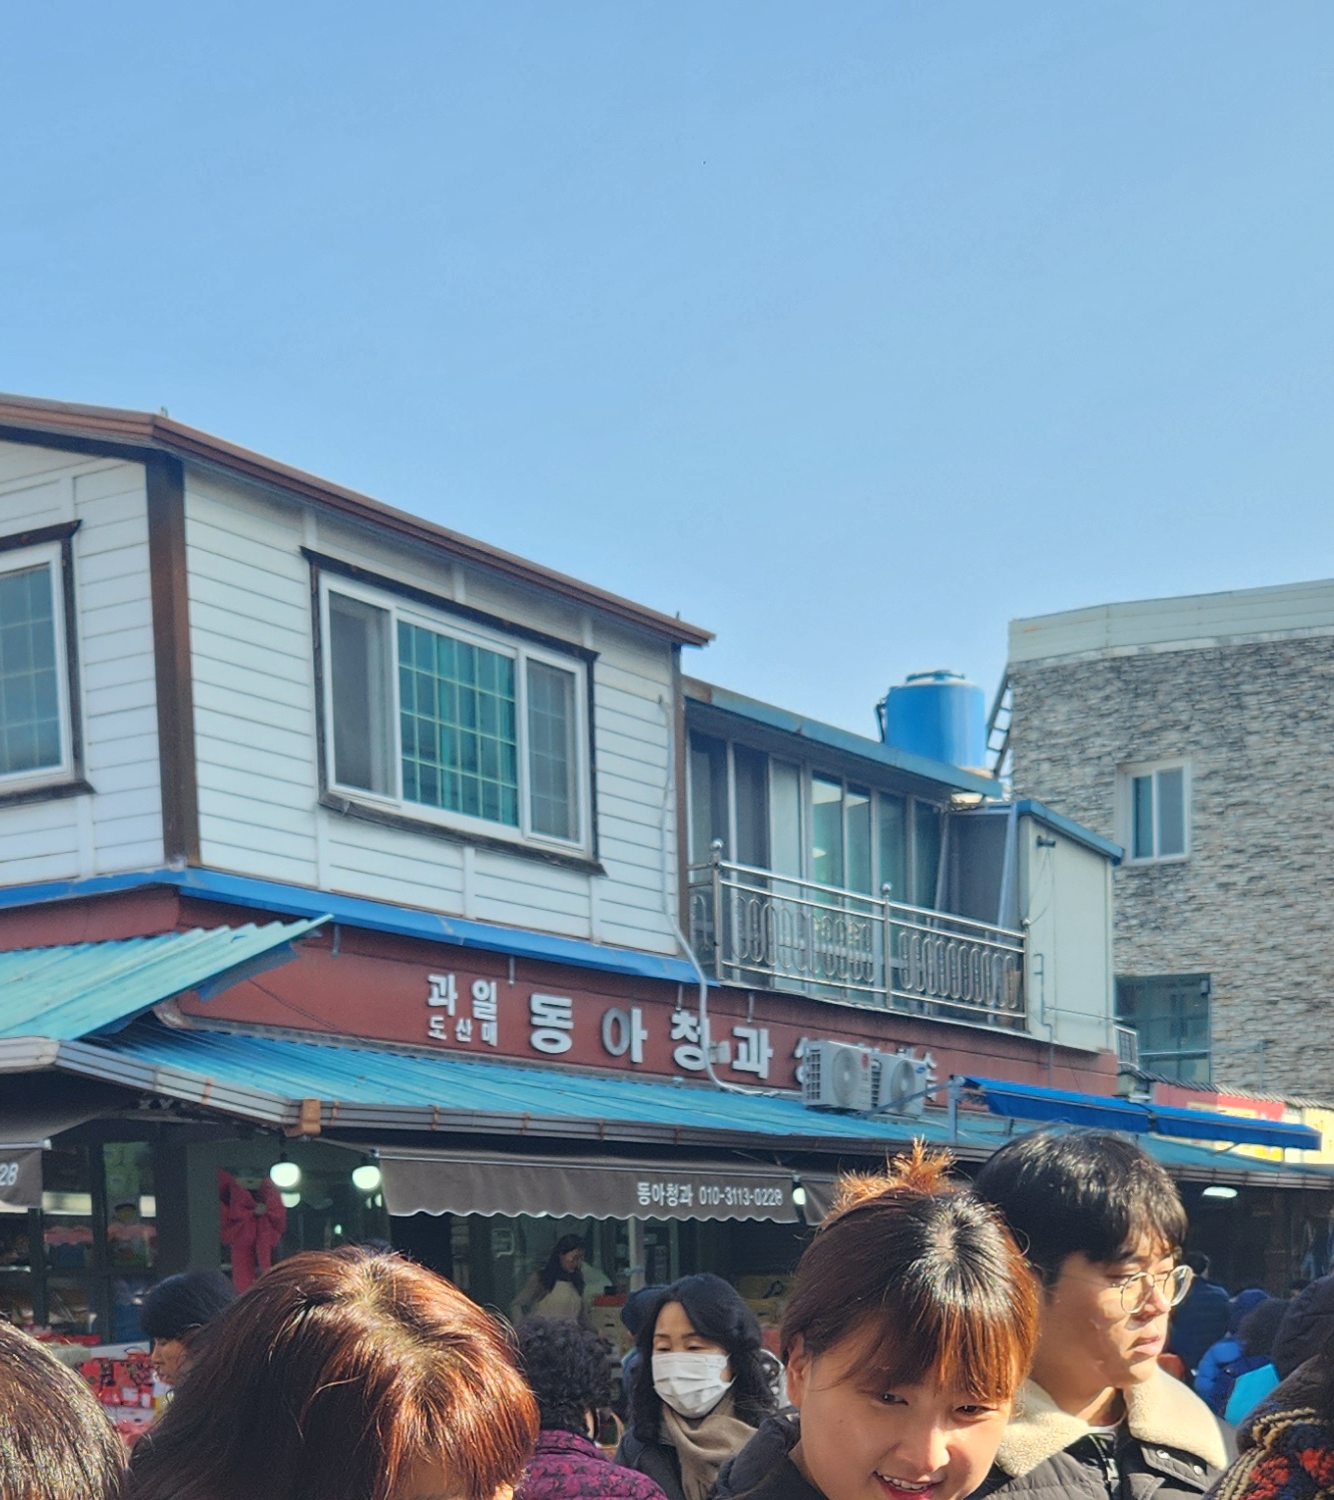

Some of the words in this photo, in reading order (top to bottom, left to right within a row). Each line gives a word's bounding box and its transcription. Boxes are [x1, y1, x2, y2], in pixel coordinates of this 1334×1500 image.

[530, 992, 774, 1080] 동아청과
[637, 1181, 693, 1207] 동아청과
[699, 1185, 783, 1206] 010-3113-0228
